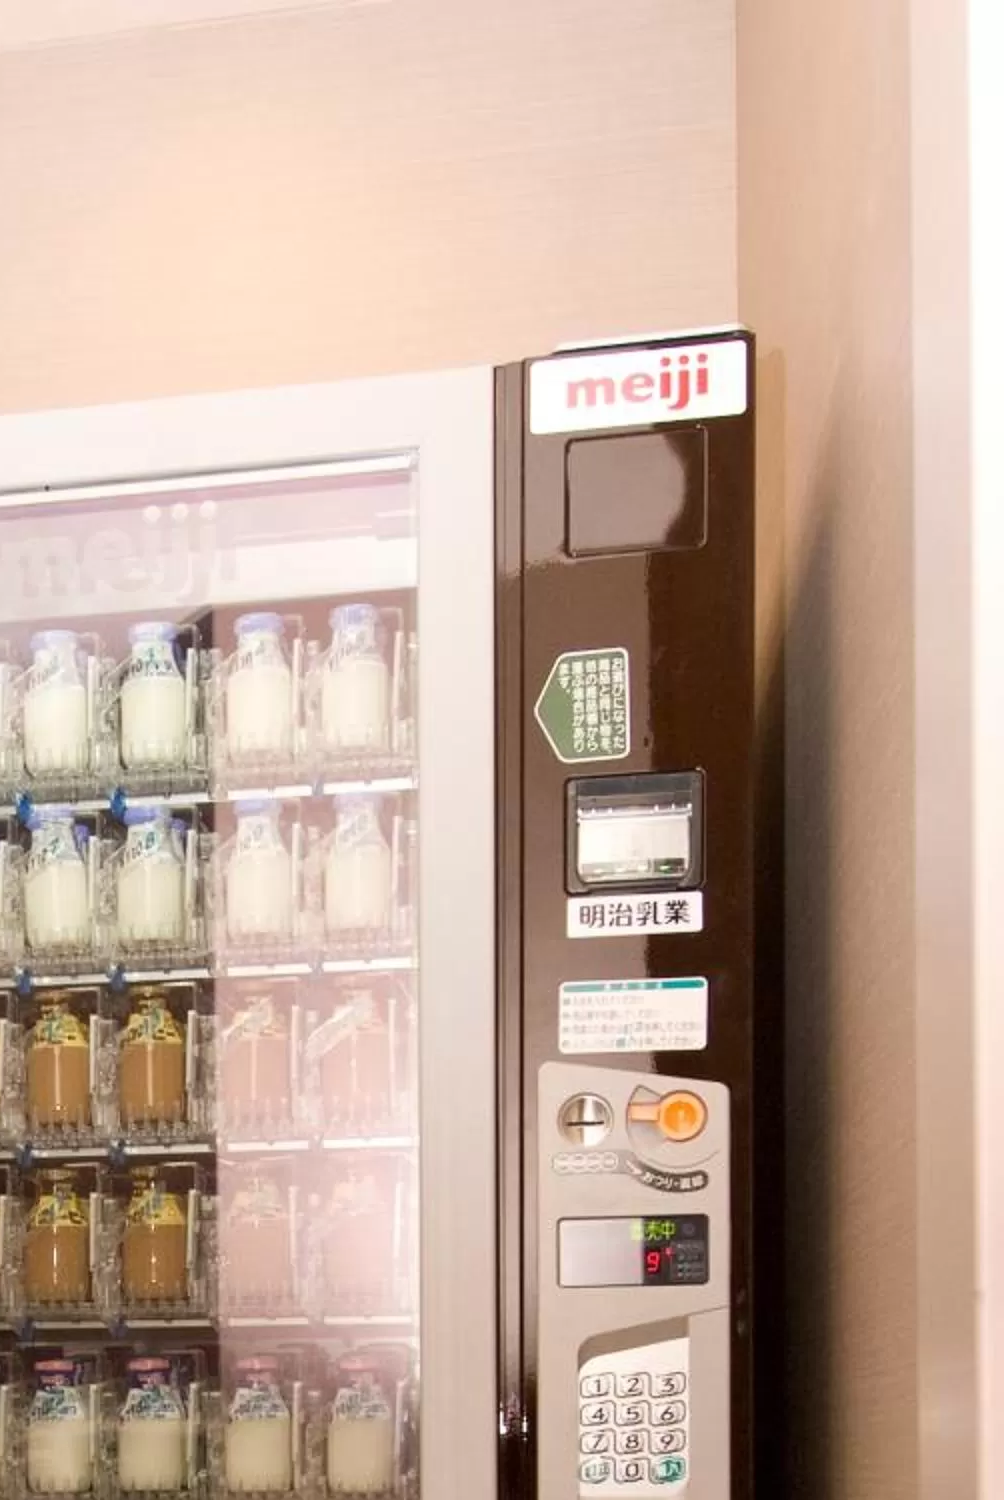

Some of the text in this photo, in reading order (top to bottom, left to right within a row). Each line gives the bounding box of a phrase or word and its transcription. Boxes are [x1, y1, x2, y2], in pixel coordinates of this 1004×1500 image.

[567, 354, 708, 410] meiji
[579, 899, 691, 928] 明治乳業
[646, 1251, 661, 1272] 9
[594, 1379, 601, 1393] 1
[628, 1377, 639, 1393] 2
[661, 1377, 675, 1393] 3
[591, 1406, 605, 1421] 4
[627, 1406, 639, 1421] 5
[661, 1406, 674, 1421] 6
[593, 1434, 605, 1449] 7
[626, 1433, 639, 1449] 8
[660, 1433, 674, 1449] 9
[626, 1462, 639, 1478] 0
